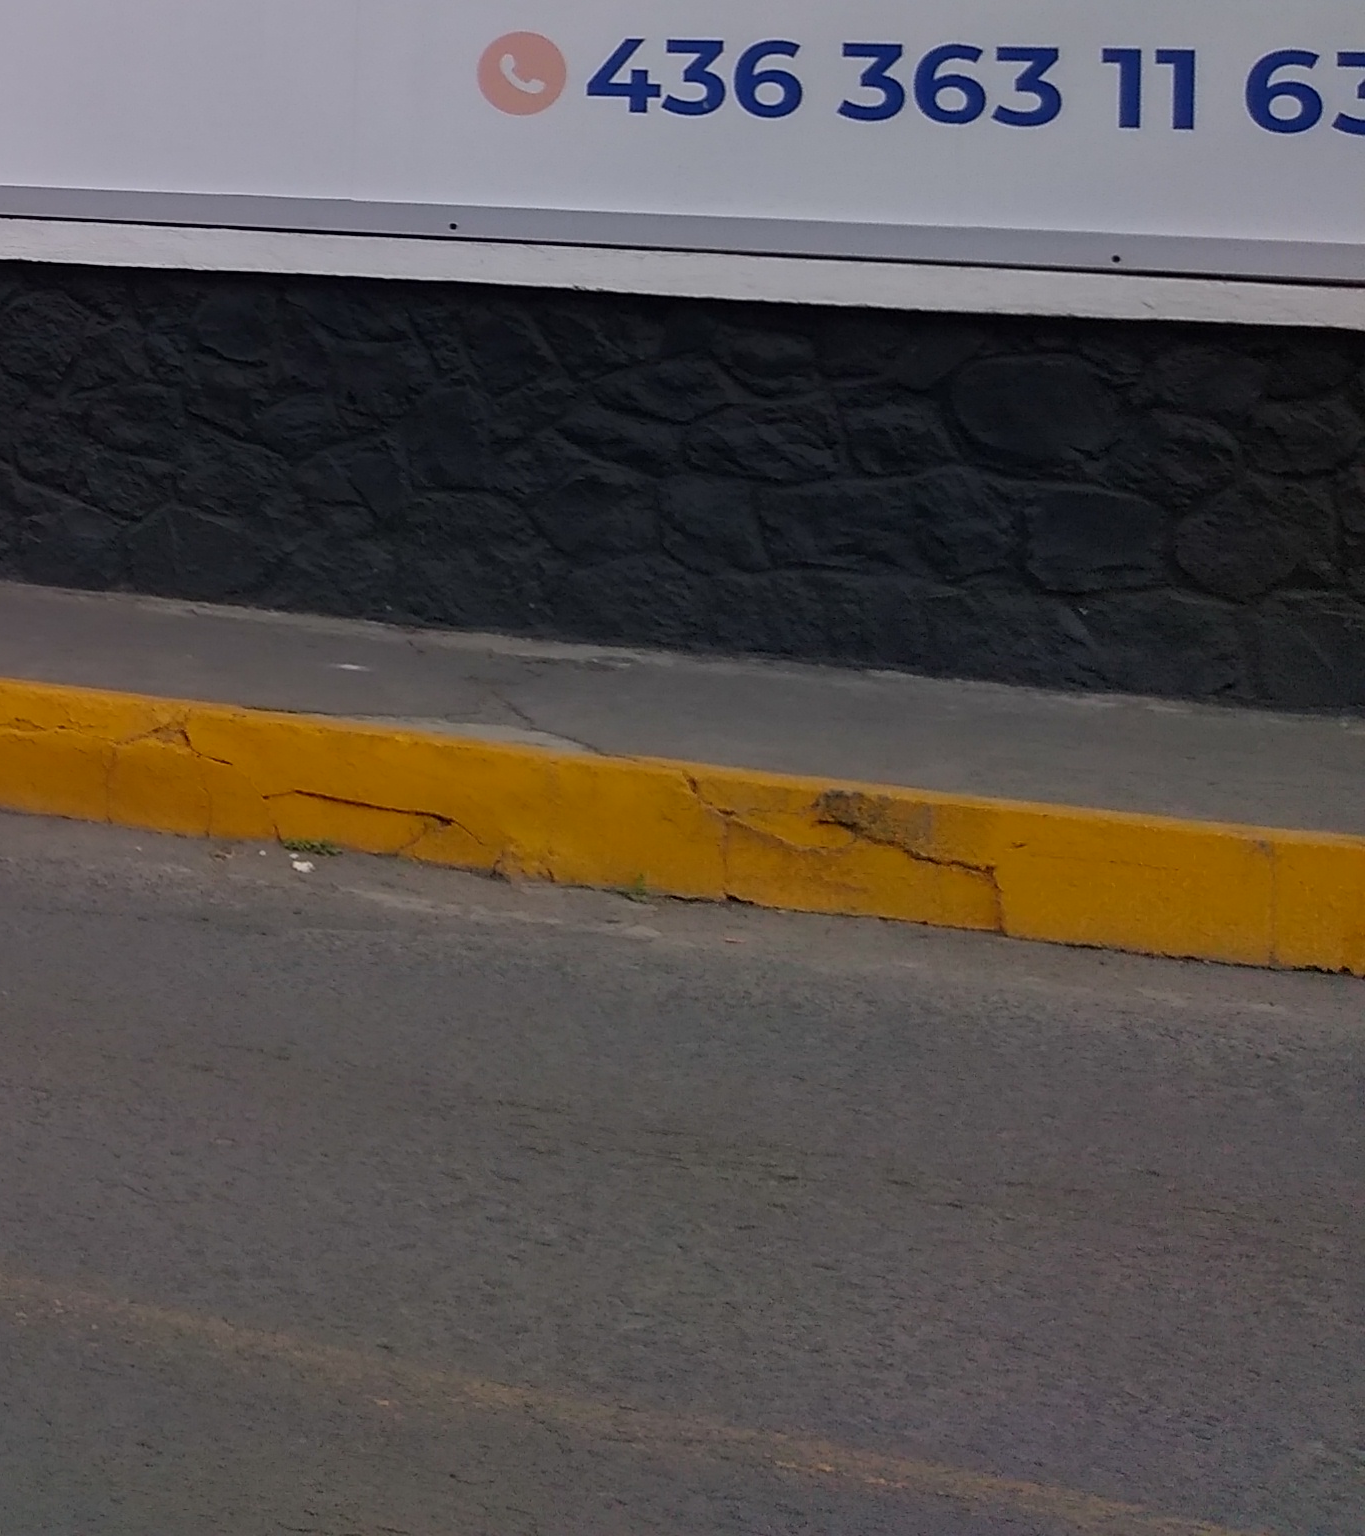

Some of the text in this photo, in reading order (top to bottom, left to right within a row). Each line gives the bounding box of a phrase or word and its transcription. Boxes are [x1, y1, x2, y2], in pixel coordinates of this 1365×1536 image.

[585, 38, 804, 119] 436
[836, 41, 1063, 129] 363
[1100, 47, 1198, 131] 11
